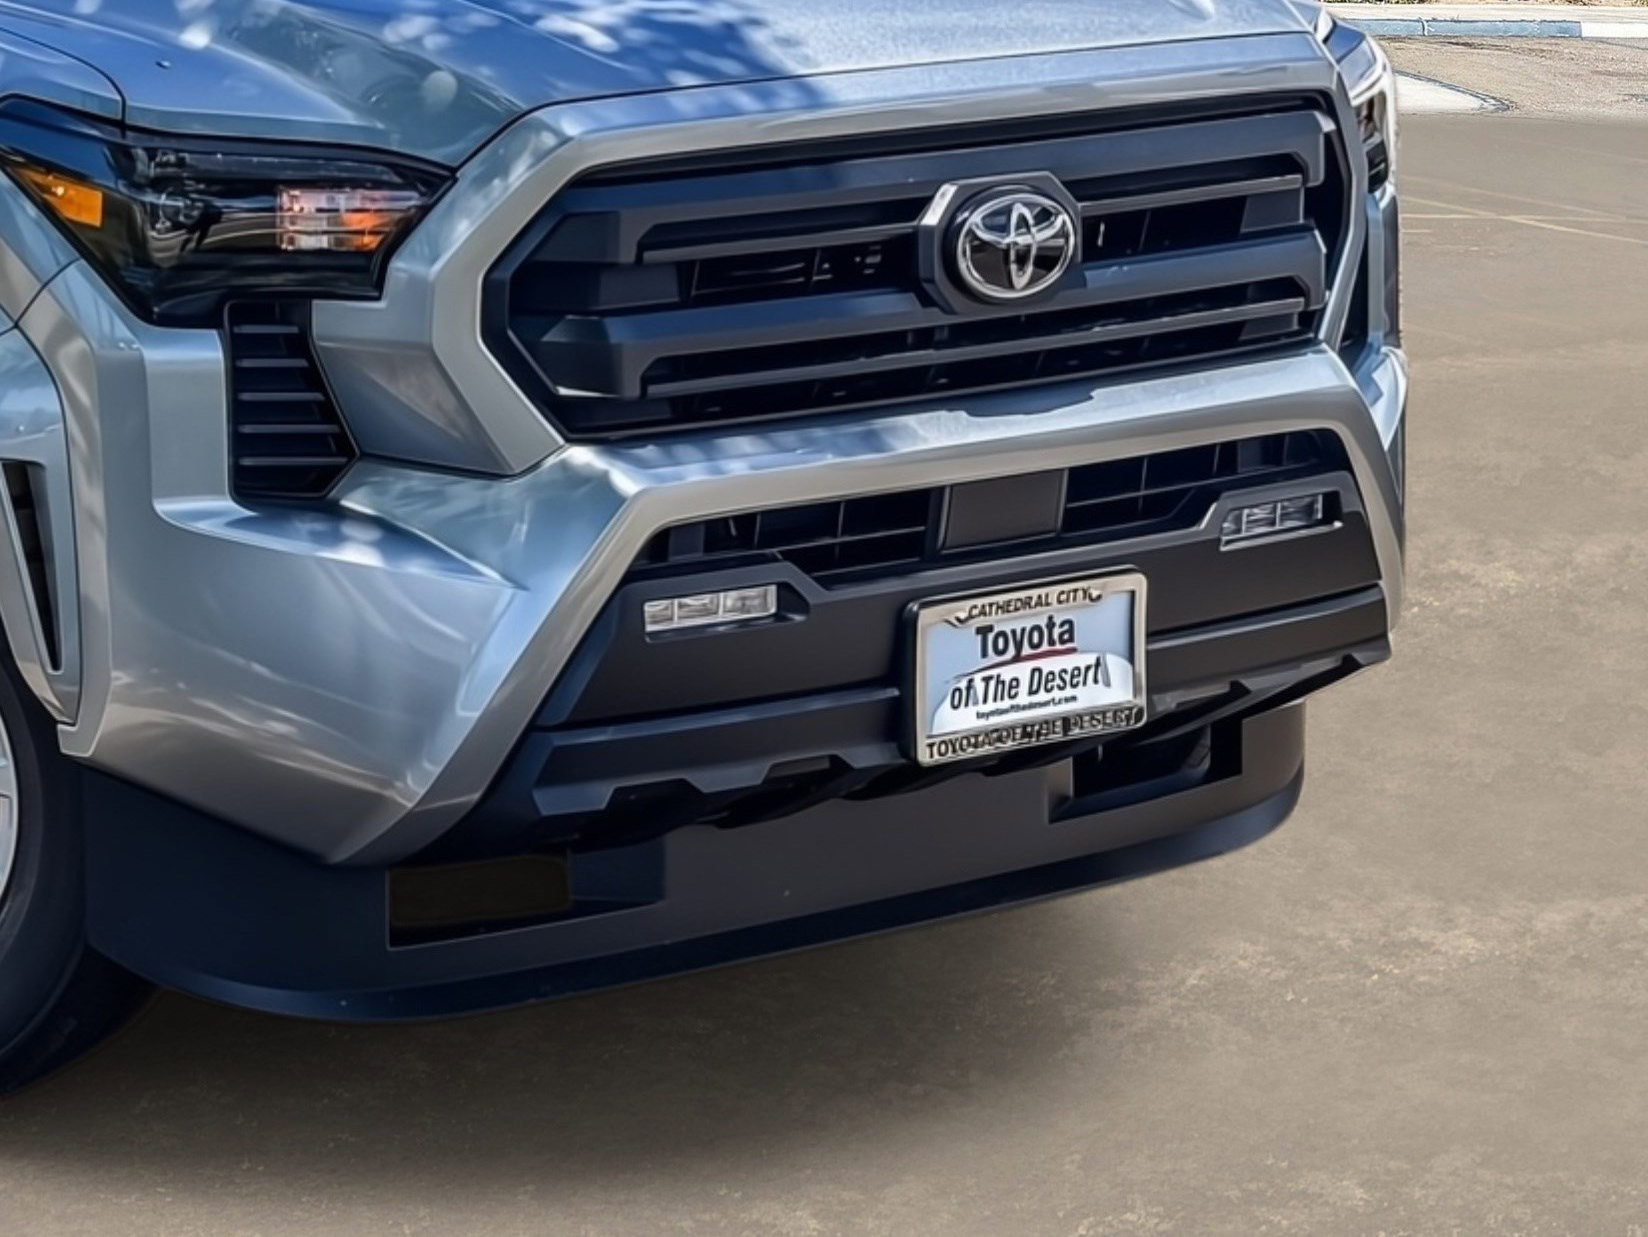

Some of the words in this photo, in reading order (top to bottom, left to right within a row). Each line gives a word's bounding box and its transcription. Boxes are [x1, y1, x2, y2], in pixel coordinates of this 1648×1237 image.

[968, 591, 1053, 619] CATHEDRAL
[1056, 586, 1091, 606] CITY
[975, 614, 1077, 661] Toyota
[950, 675, 975, 711] of
[981, 674, 1020, 705] The
[1028, 655, 1102, 697] Desert
